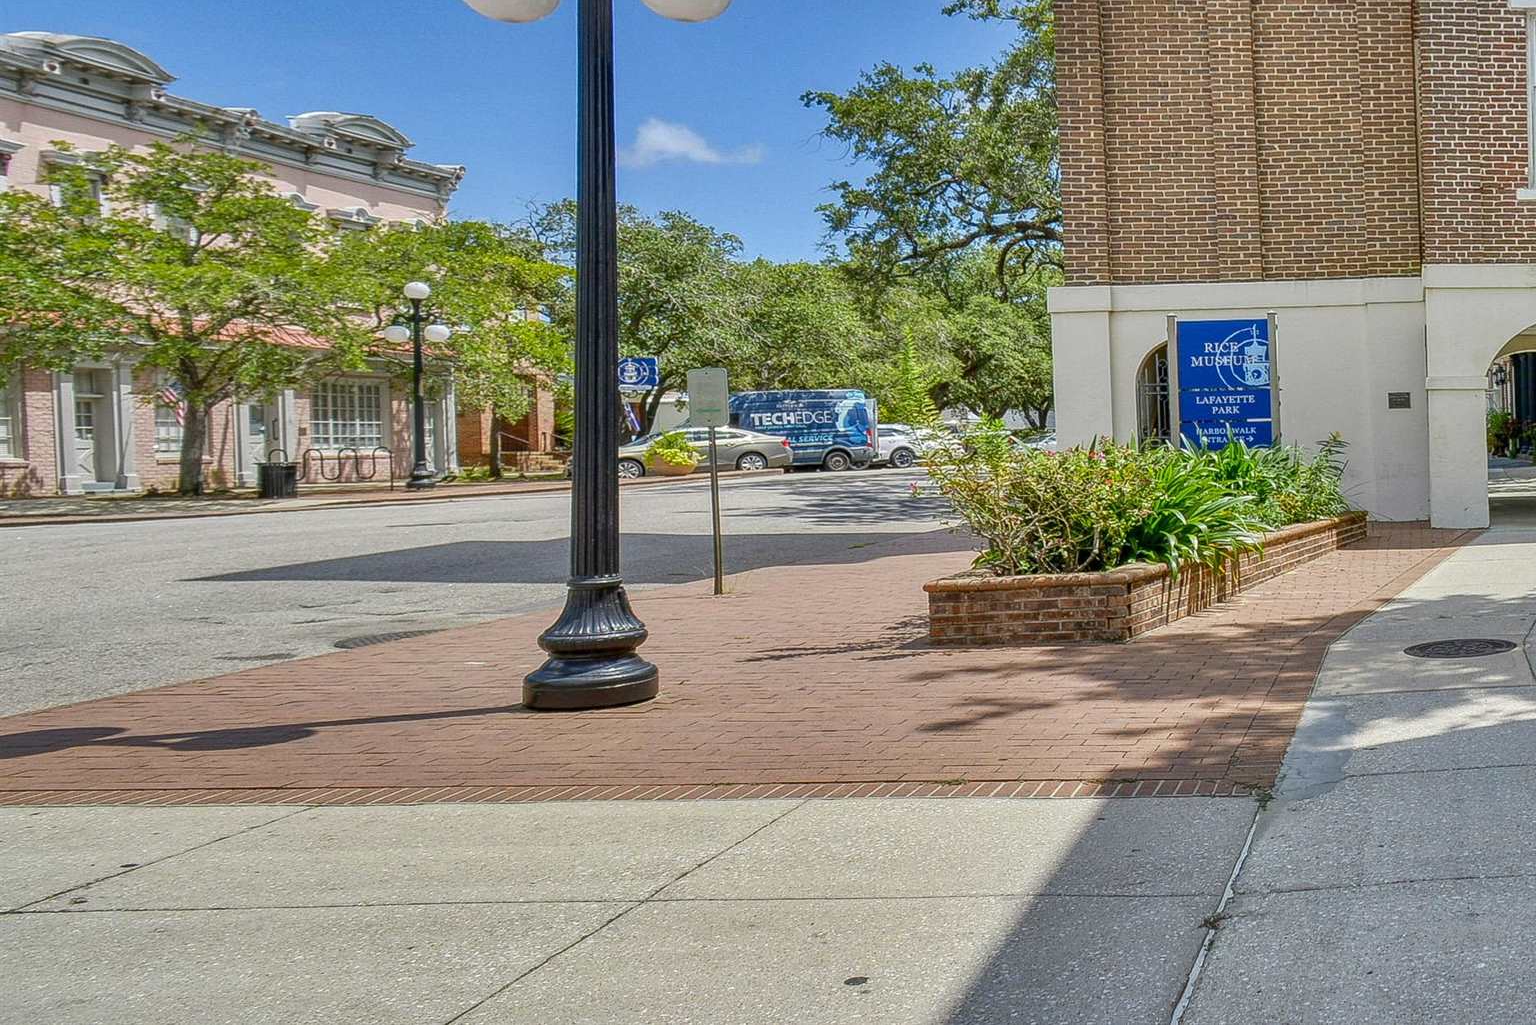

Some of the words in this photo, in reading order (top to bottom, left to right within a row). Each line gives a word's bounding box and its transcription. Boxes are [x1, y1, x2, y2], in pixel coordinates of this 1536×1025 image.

[1203, 342, 1239, 353] RICE
[1190, 355, 1255, 367] MUSEUM
[1195, 395, 1256, 405] LAFAYETTE
[1212, 406, 1240, 415] PARK
[750, 411, 833, 426] TECHEDGE
[1196, 427, 1257, 435] ARBOWALK
[798, 434, 833, 443] SERVICE
